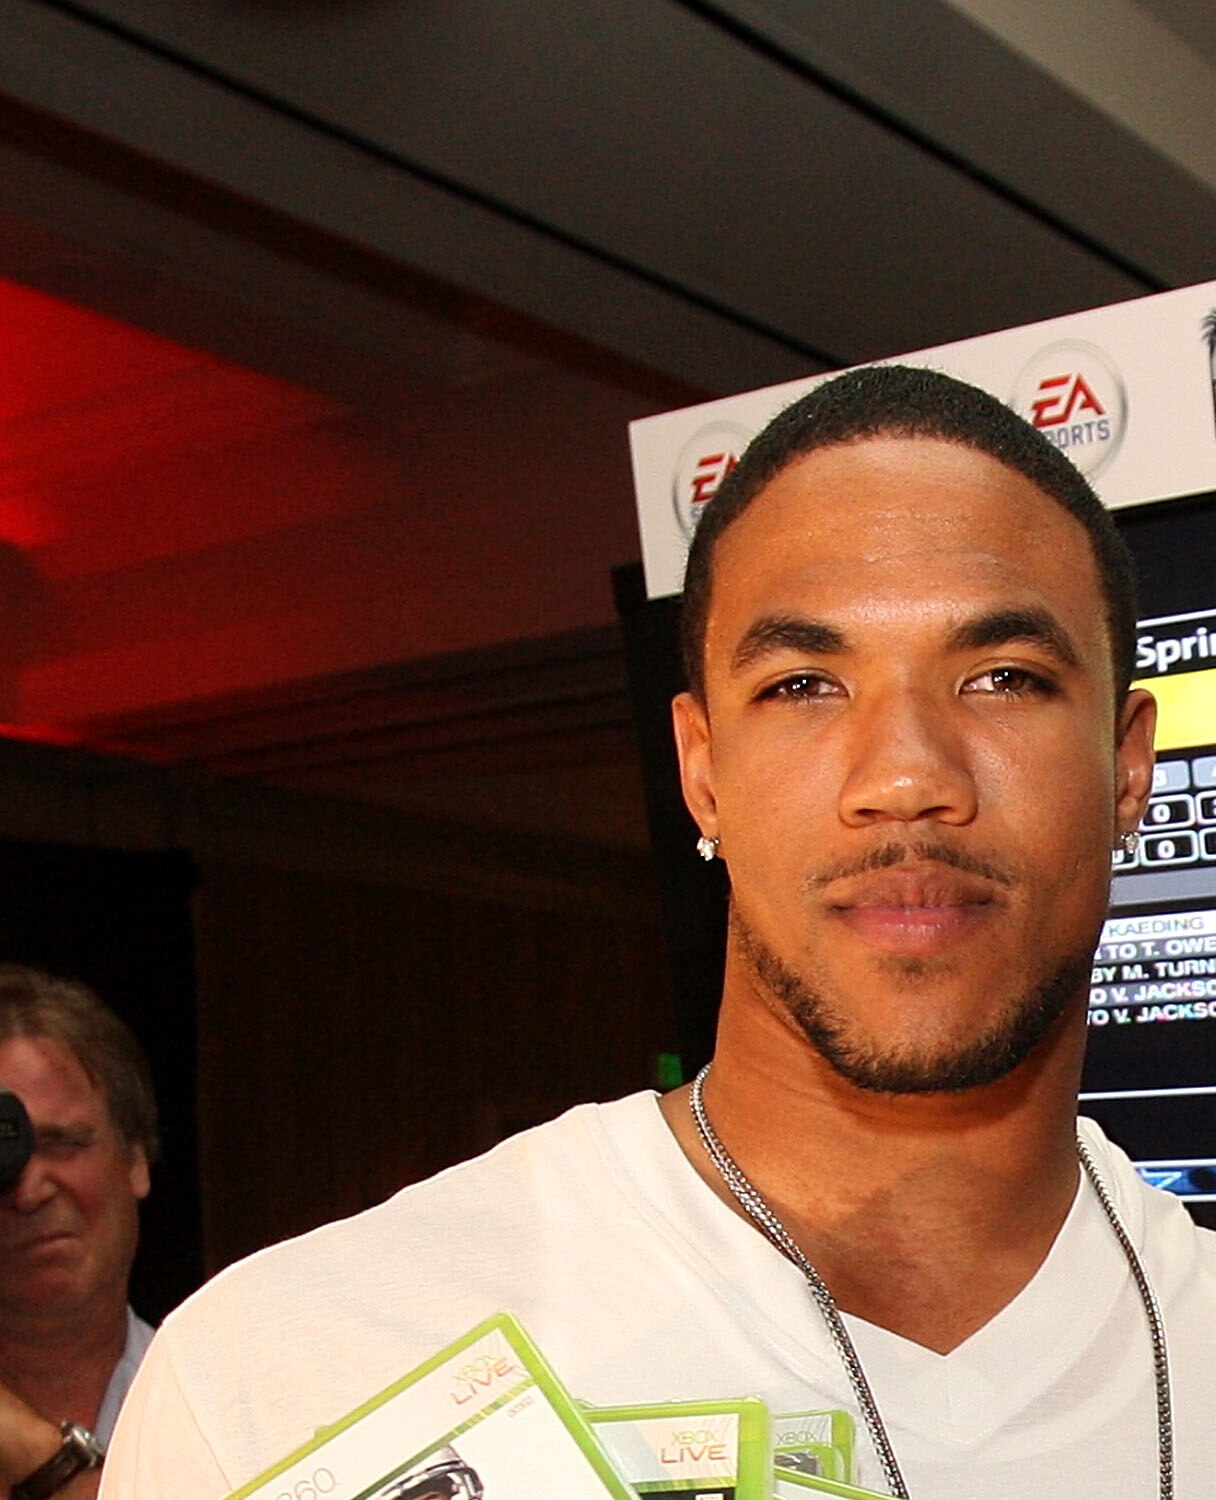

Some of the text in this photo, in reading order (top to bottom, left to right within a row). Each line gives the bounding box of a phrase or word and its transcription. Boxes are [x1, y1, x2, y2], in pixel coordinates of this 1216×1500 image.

[1031, 373, 1105, 428] EA
[1043, 419, 1110, 449] PORTS
[1108, 916, 1205, 937] KAEDING
[1107, 944, 1137, 960] TO
[1142, 941, 1160, 956] T.
[1122, 963, 1149, 979] M.
[1111, 988, 1129, 1002] V.
[1112, 1008, 1131, 1023] V.
[450, 1356, 514, 1405] LIVE
[671, 1429, 720, 1446] XBOX
[776, 1431, 817, 1447] XBOX
[660, 1443, 729, 1465] LIVE
